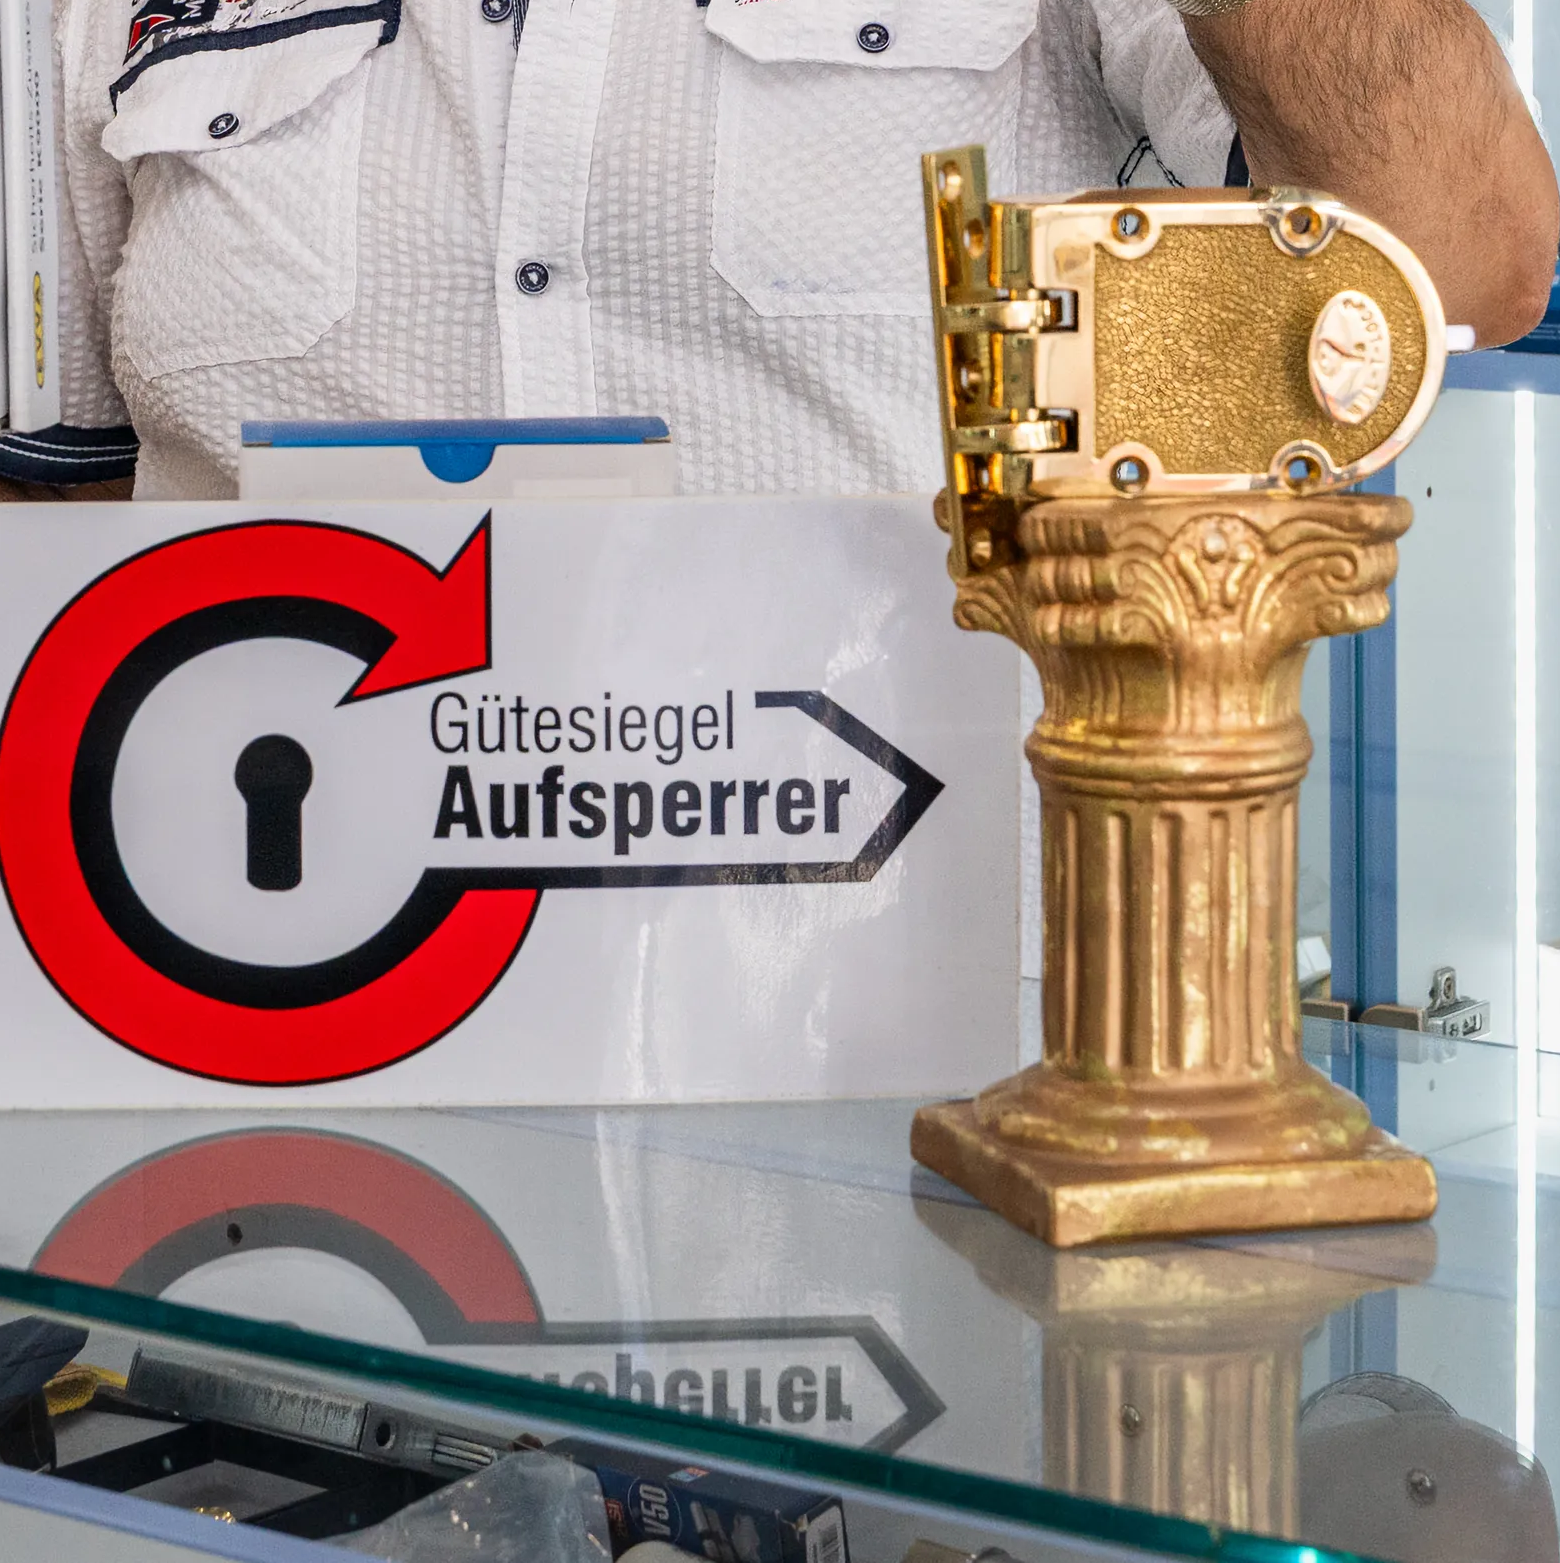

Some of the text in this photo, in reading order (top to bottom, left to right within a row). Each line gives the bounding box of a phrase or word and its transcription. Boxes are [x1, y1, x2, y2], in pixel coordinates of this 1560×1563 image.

[429, 689, 734, 766] Gütesiegel
[433, 763, 851, 856] Aufsperrer
[639, 1483, 672, 1538] V50
